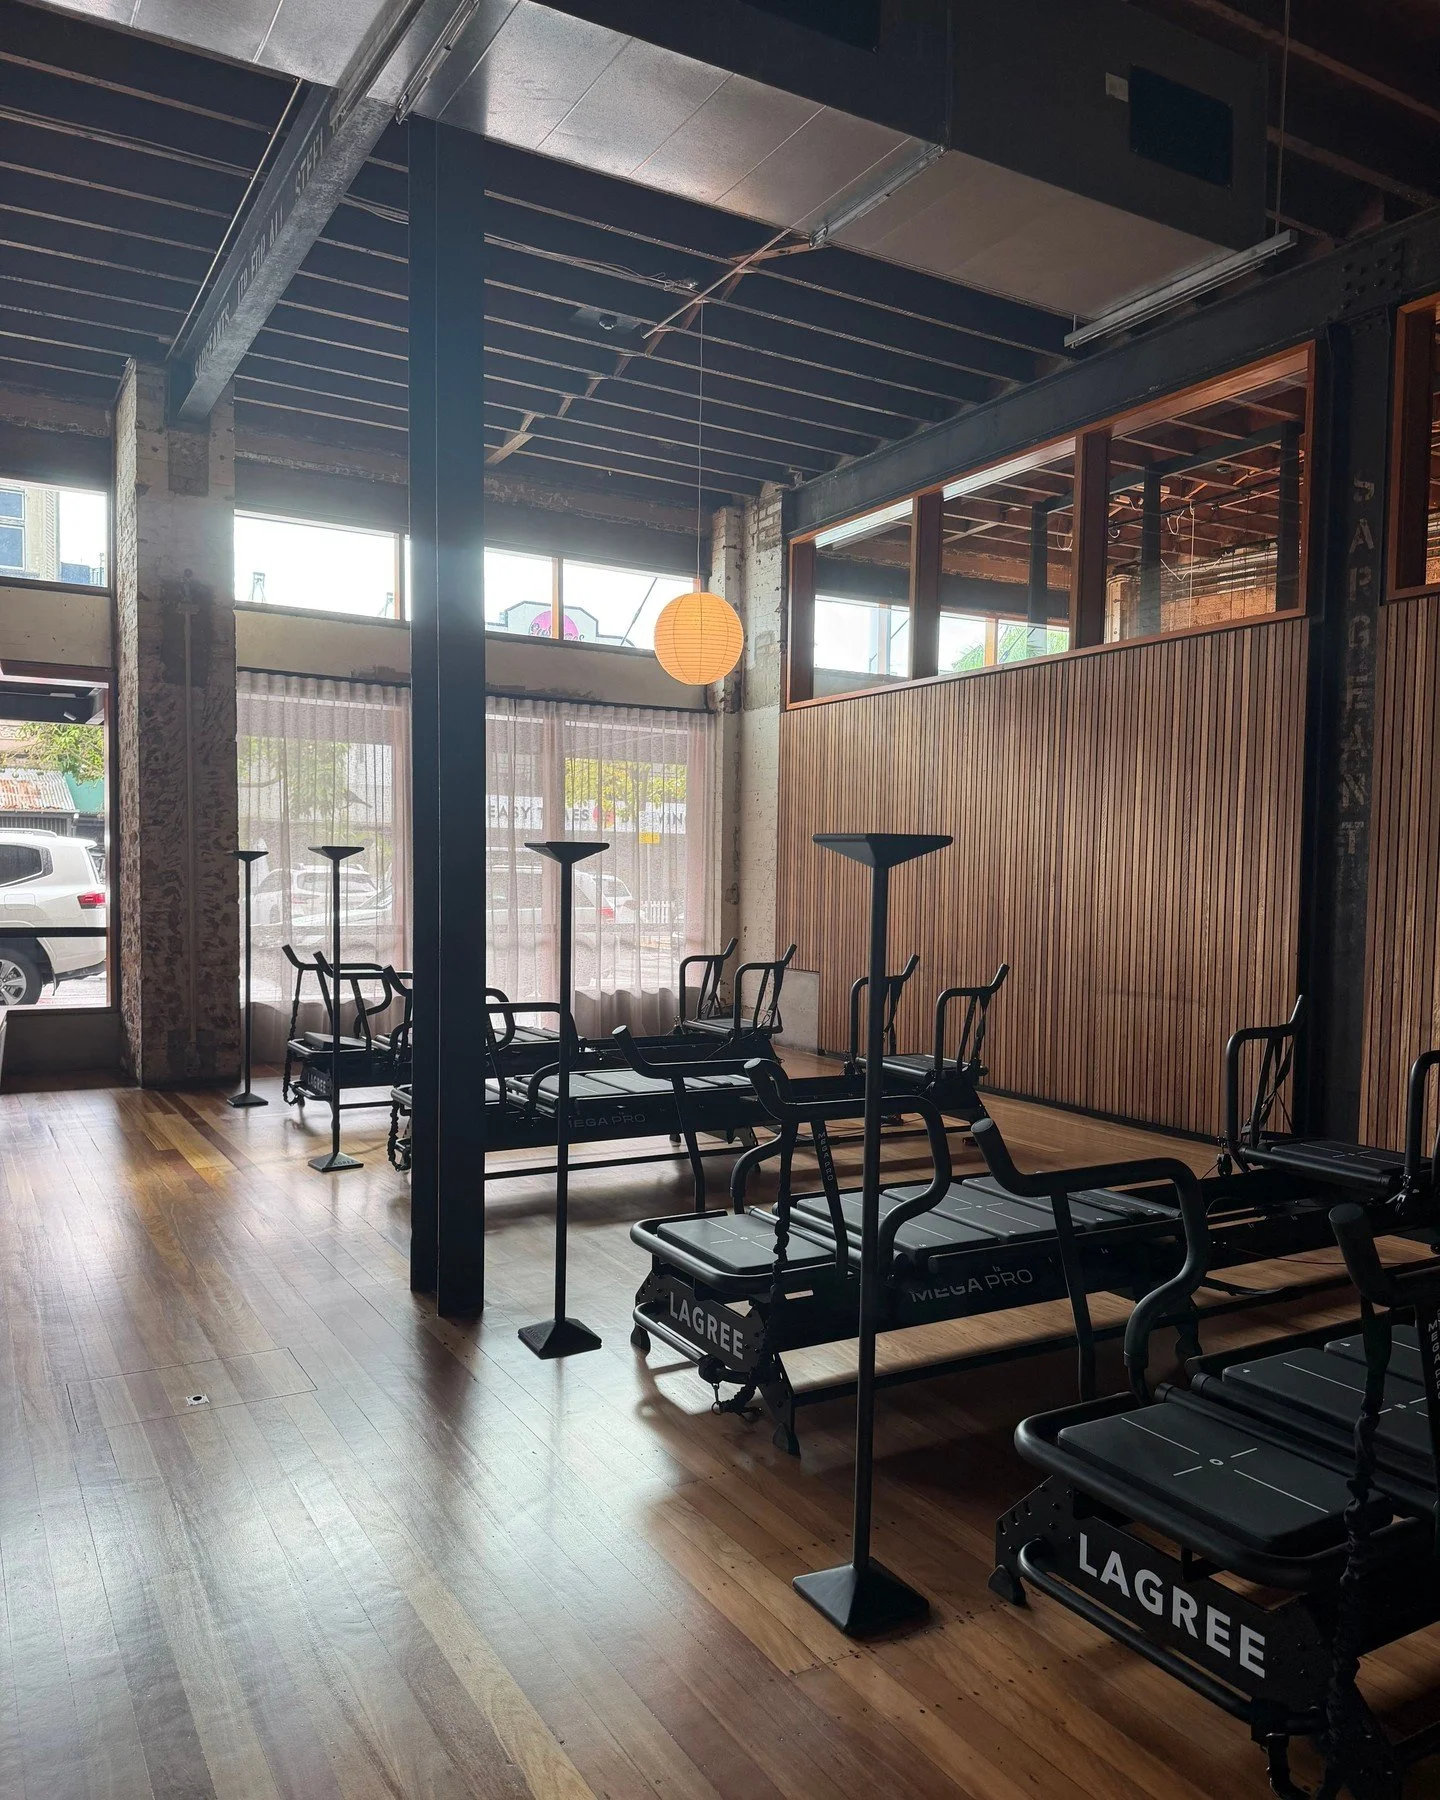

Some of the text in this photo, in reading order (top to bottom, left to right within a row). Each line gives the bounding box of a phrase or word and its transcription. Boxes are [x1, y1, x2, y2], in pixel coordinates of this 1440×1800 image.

[488, 804, 530, 820] EASY
[611, 1113, 646, 1125] PRO
[818, 1132, 834, 1181] MEGA PRO
[909, 1268, 1034, 1303] MEGA PRO
[670, 1291, 744, 1360] LAGREE
[1079, 1531, 1266, 1679] LAGREE
